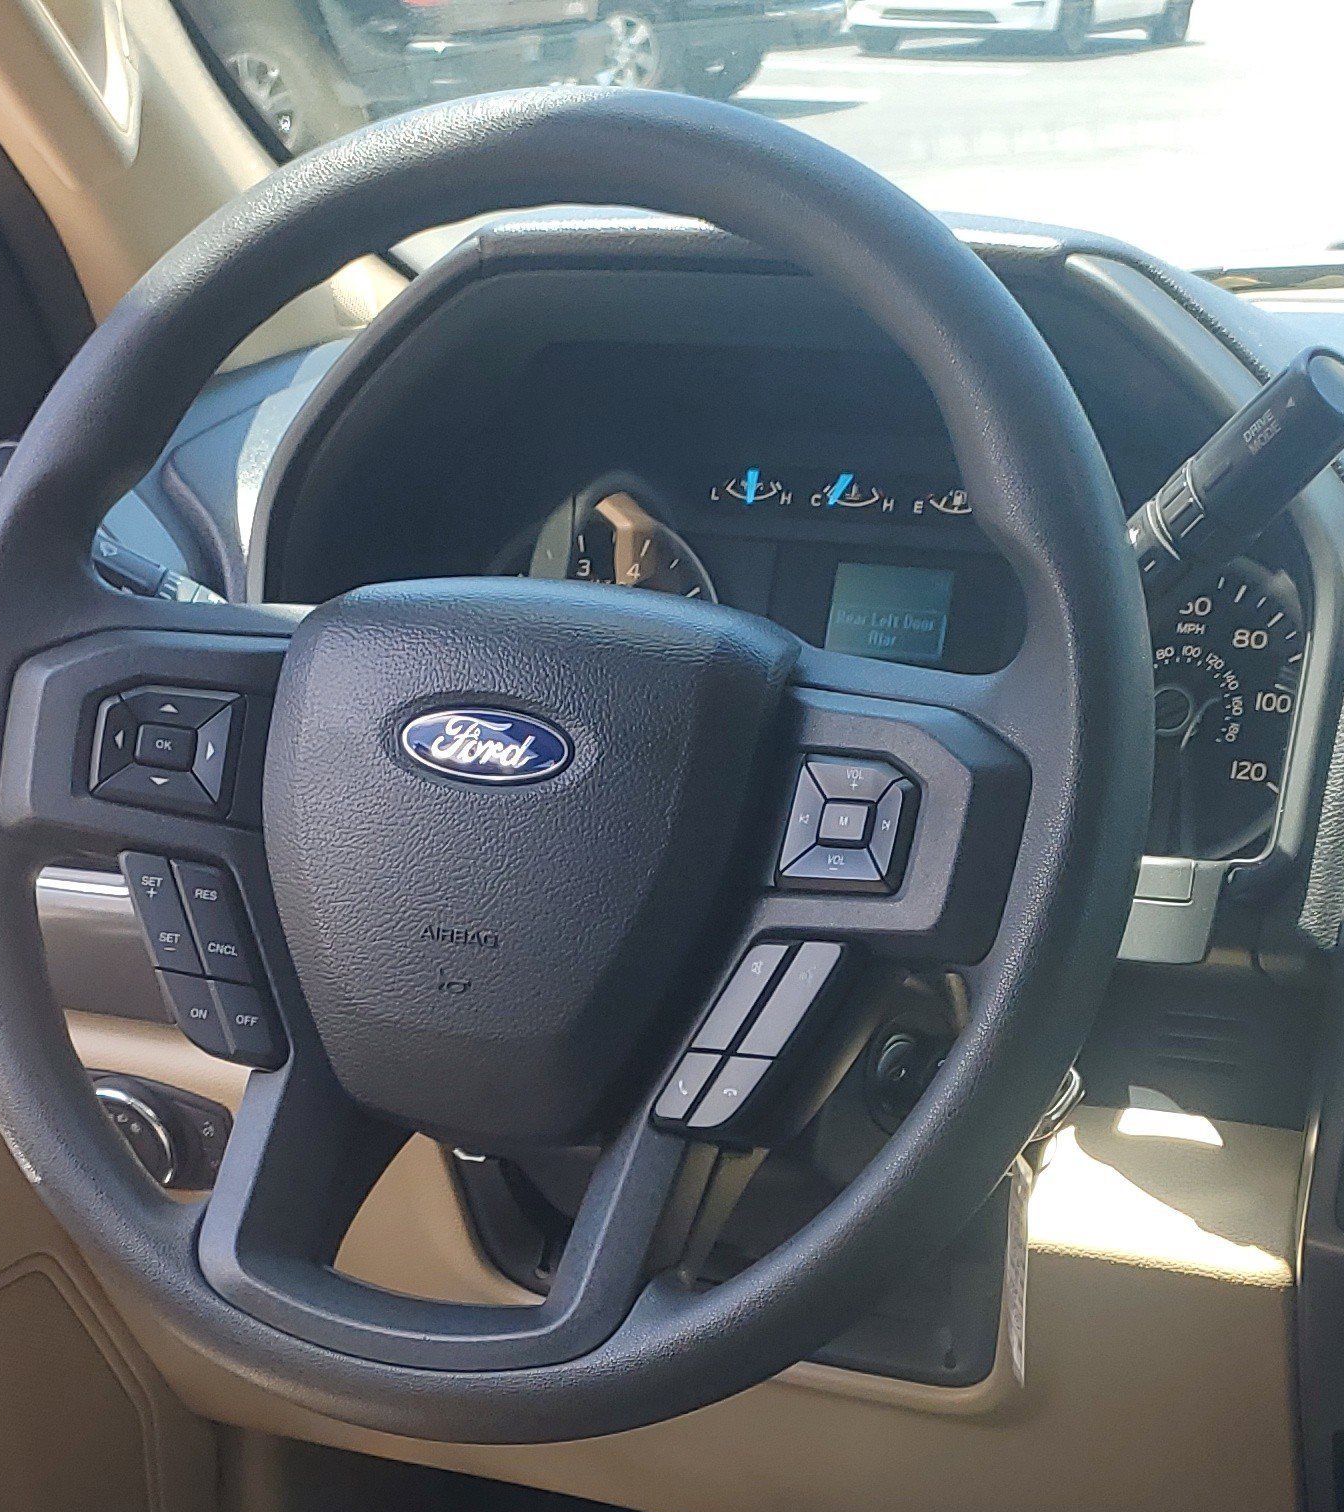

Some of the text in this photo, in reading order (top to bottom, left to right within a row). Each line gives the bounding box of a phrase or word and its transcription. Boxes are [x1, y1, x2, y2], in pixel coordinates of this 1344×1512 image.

[1242, 408, 1275, 443] DRIVE
[1247, 420, 1282, 456] MODE
[710, 487, 720, 501] L
[779, 491, 793, 505] H
[810, 493, 821, 507] C
[882, 498, 895, 513] H
[913, 500, 924, 515] E
[576, 559, 591, 577] 3
[626, 563, 641, 579] 4
[1176, 622, 1205, 635] MPH
[1232, 628, 1268, 649] 80
[1156, 646, 1175, 660] 80
[1181, 645, 1202, 657] 100
[1206, 652, 1225, 669] 120
[1255, 692, 1292, 713] 100
[155, 739, 172, 751] OK
[431, 715, 539, 769] Ford
[846, 769, 864, 779] VOL
[1230, 760, 1268, 781] 120
[838, 816, 849, 827] M
[827, 854, 845, 865] VOL
[141, 875, 163, 888] SET
[194, 888, 218, 901] RES
[159, 932, 180, 945] SET
[207, 942, 238, 957] CNCL
[190, 1007, 207, 1020] ON
[235, 1013, 258, 1027] OFF
